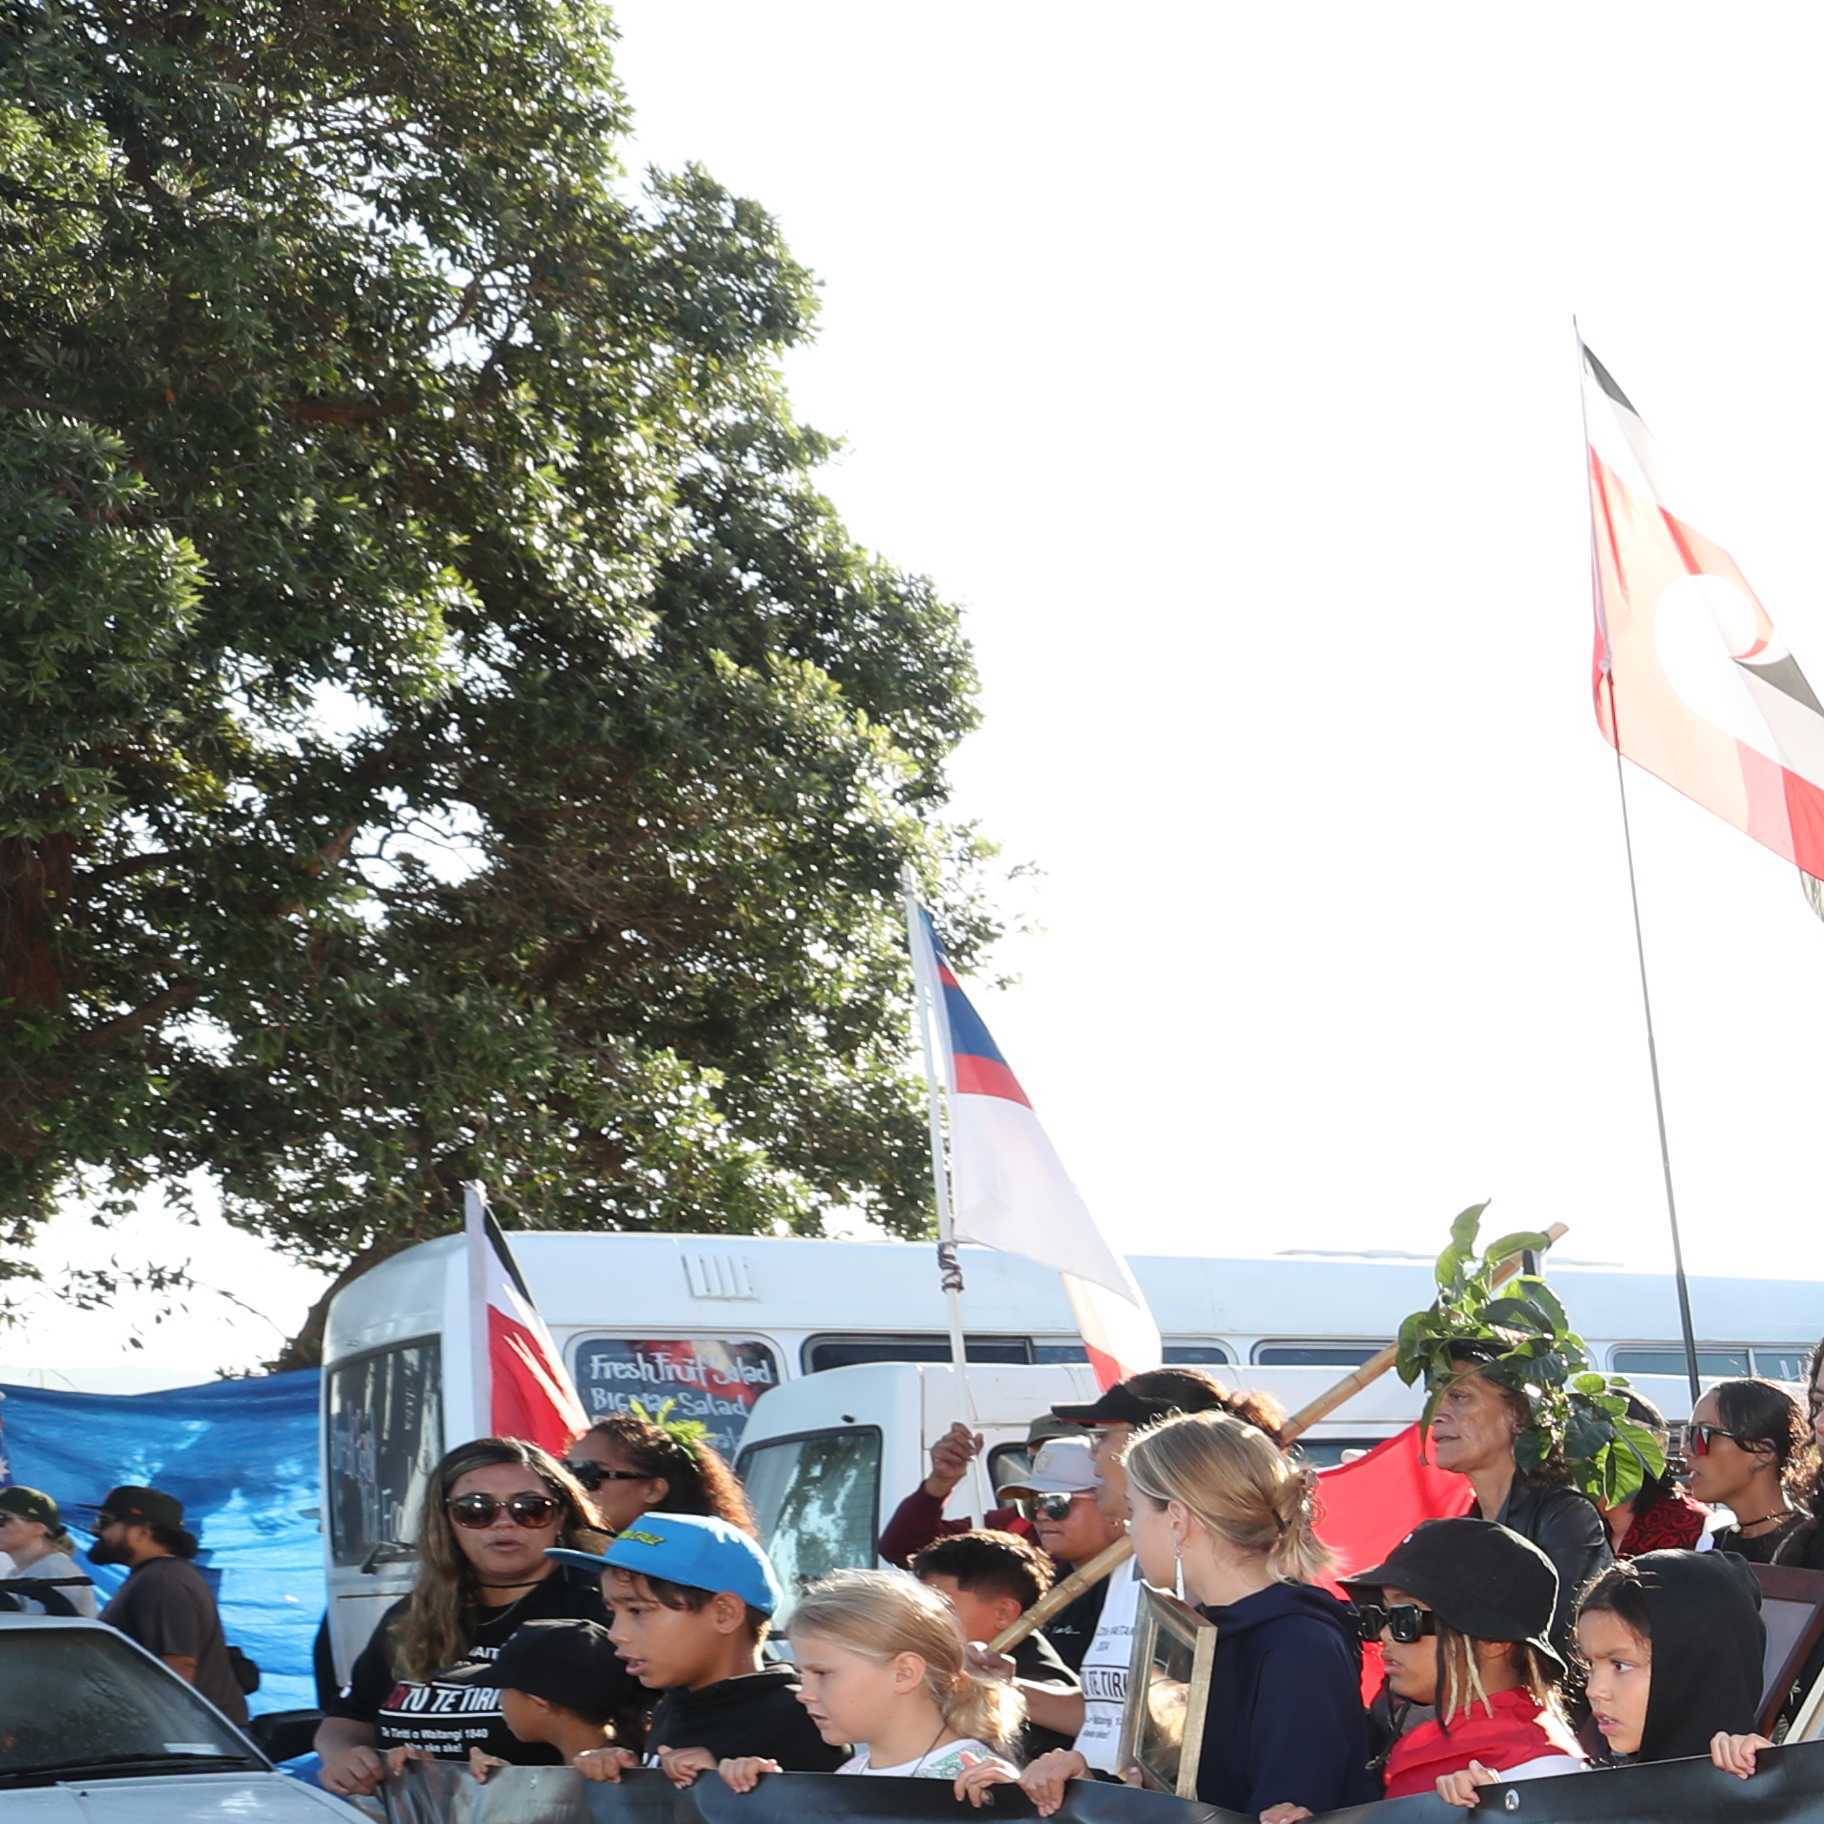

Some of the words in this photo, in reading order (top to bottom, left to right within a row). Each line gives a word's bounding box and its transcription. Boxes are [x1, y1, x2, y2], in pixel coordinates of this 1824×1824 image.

[589, 1353, 660, 1384] Fresh
[649, 1352, 709, 1388] Fruit
[678, 1392, 749, 1418] Salad
[429, 1690, 463, 1712] TE
